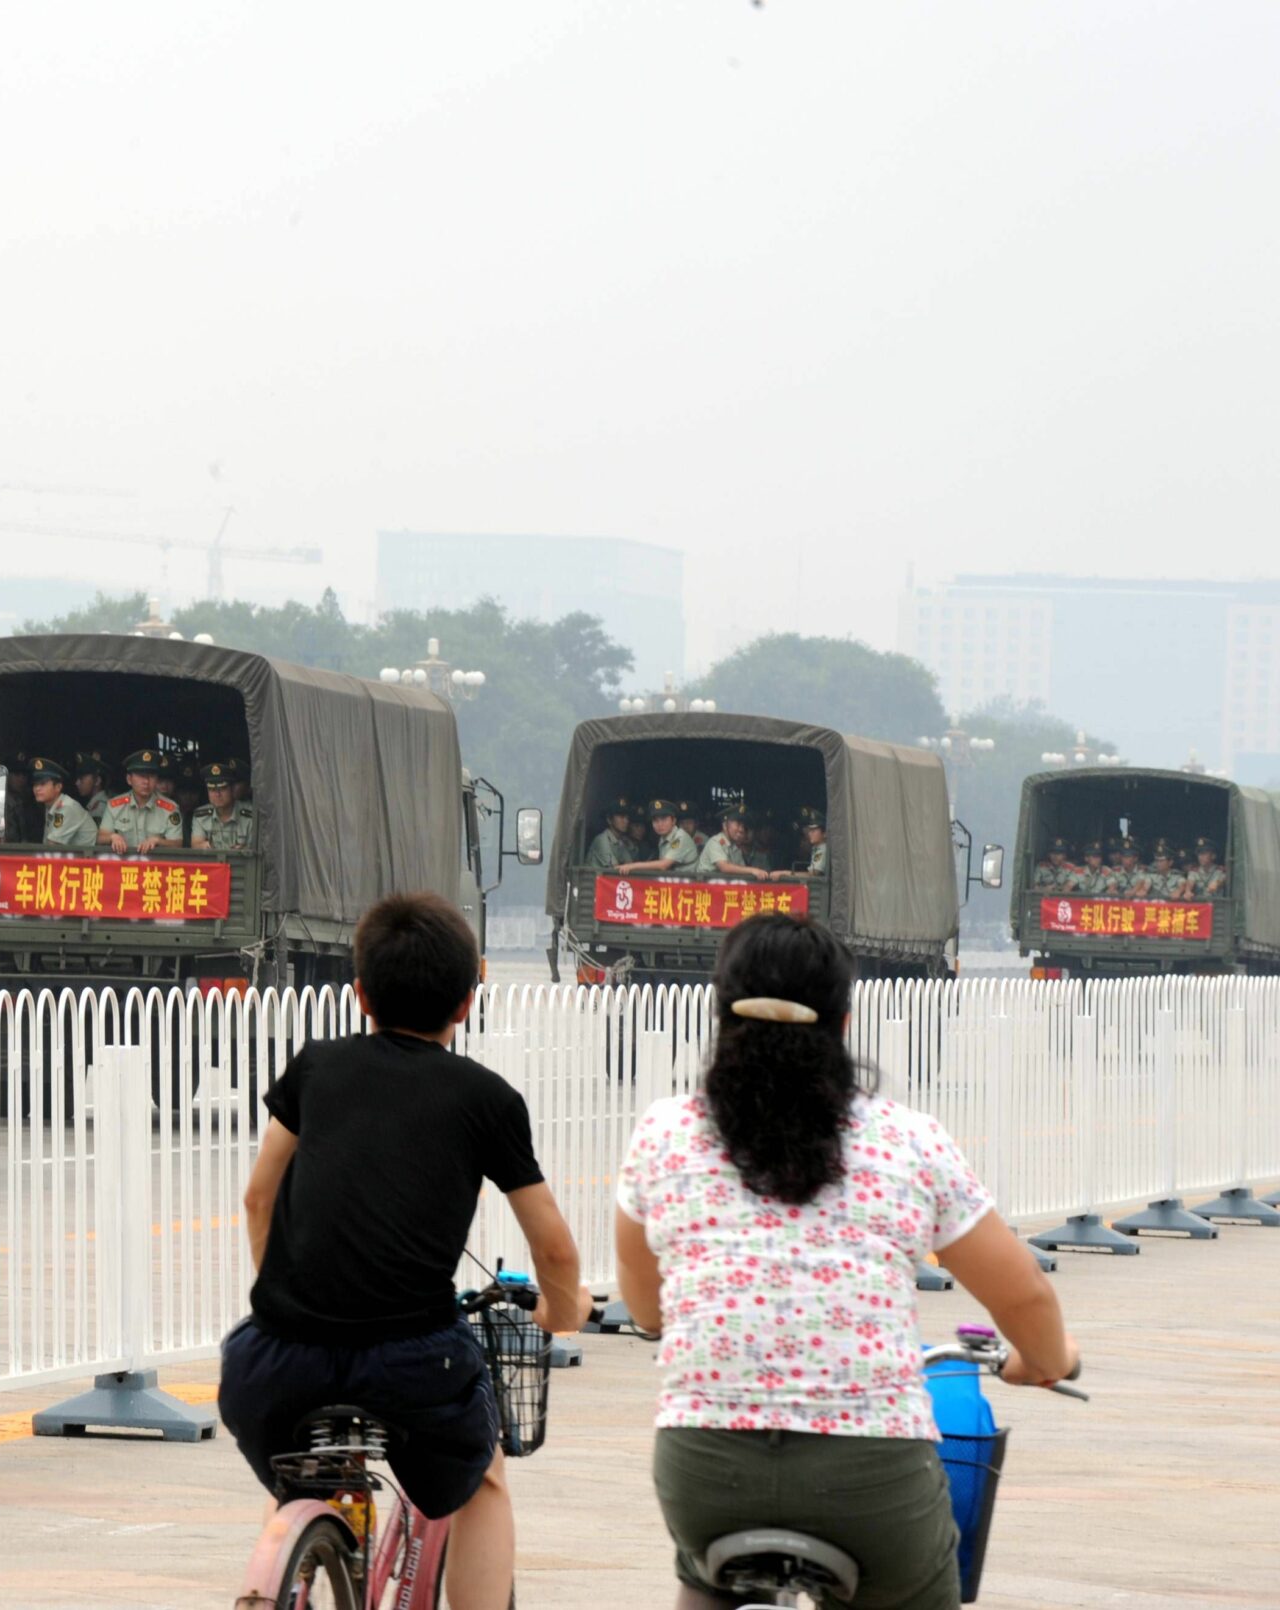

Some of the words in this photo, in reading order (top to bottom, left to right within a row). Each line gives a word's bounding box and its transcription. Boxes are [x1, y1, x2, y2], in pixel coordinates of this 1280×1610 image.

[14, 863, 104, 912] 车队行驶
[117, 866, 209, 914] 严禁插车
[643, 887, 712, 922] 车队行驶
[1081, 904, 1135, 932] 车队行驶
